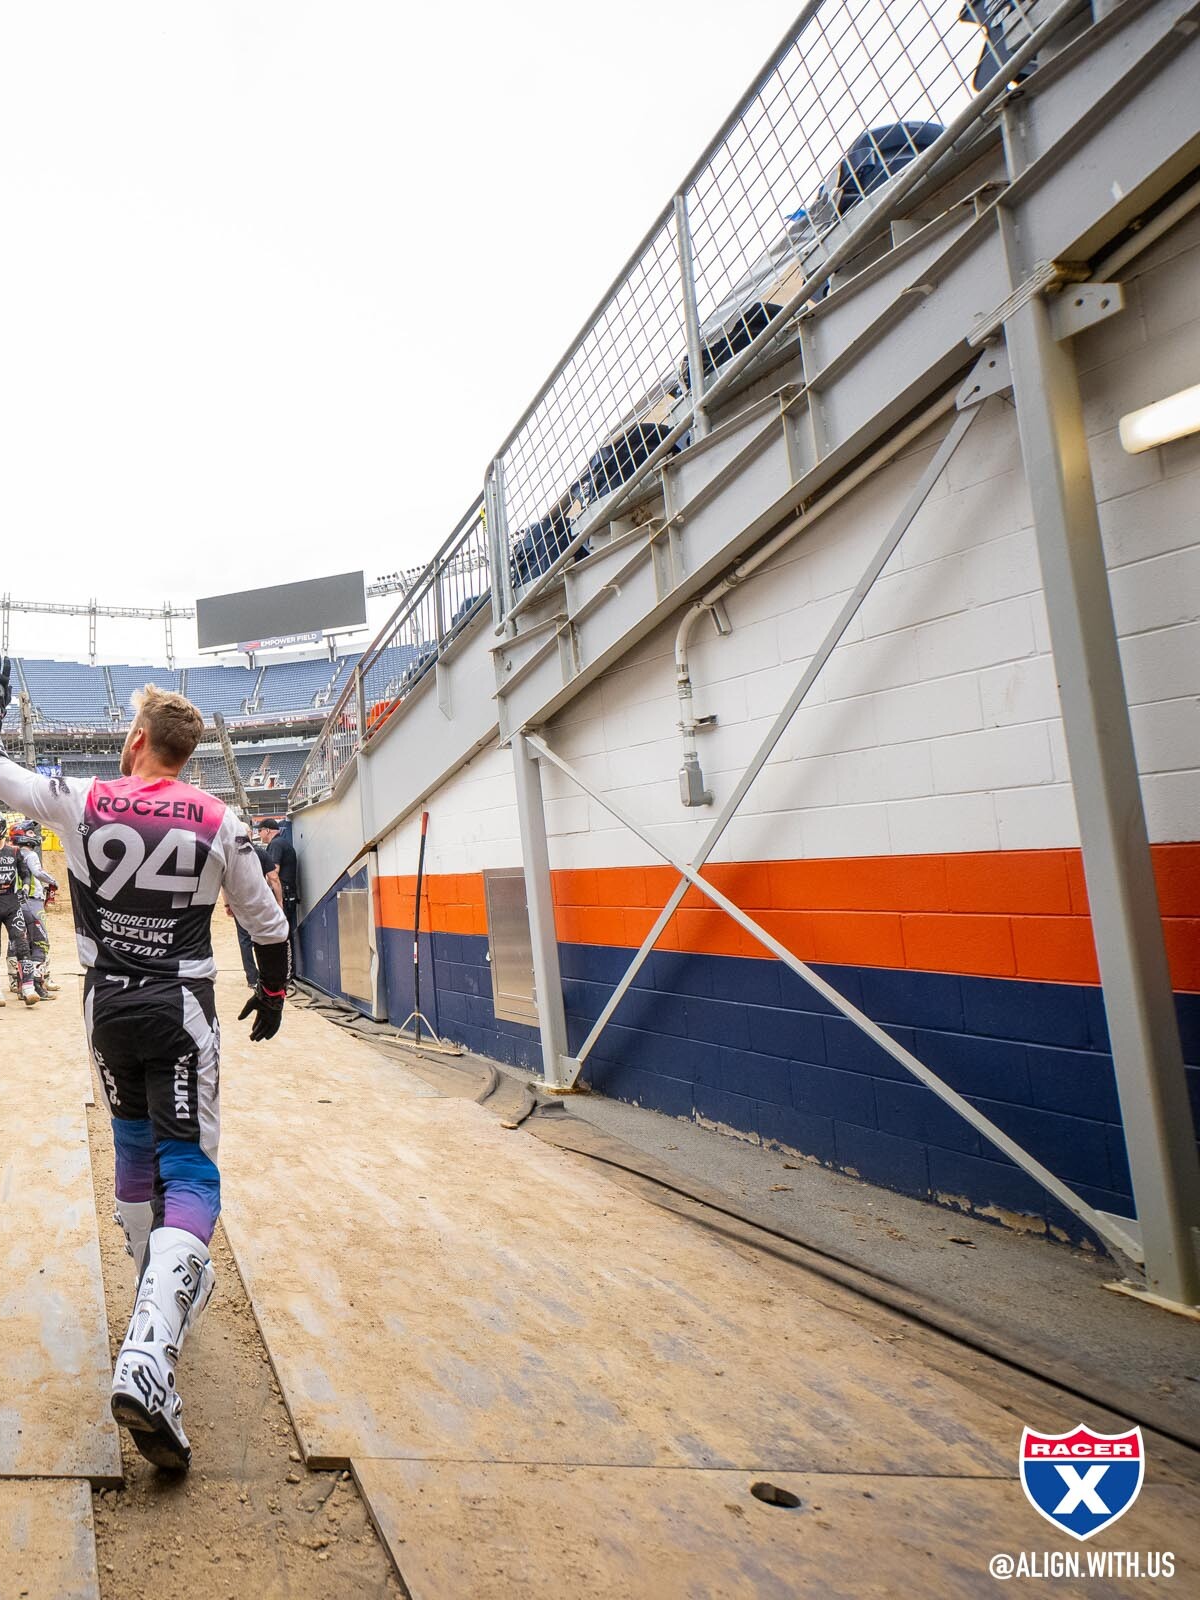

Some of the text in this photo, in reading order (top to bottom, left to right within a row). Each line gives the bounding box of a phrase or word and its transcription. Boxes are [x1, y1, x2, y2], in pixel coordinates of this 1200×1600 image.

[261, 633, 317, 647] EMPOWER FIELD
[97, 796, 204, 823] ROCZEN
[87, 823, 200, 909] 94
[97, 907, 178, 928] PROGRESSIVE
[101, 919, 174, 944] SUZUKI
[120, 1362, 129, 1382] FOX
